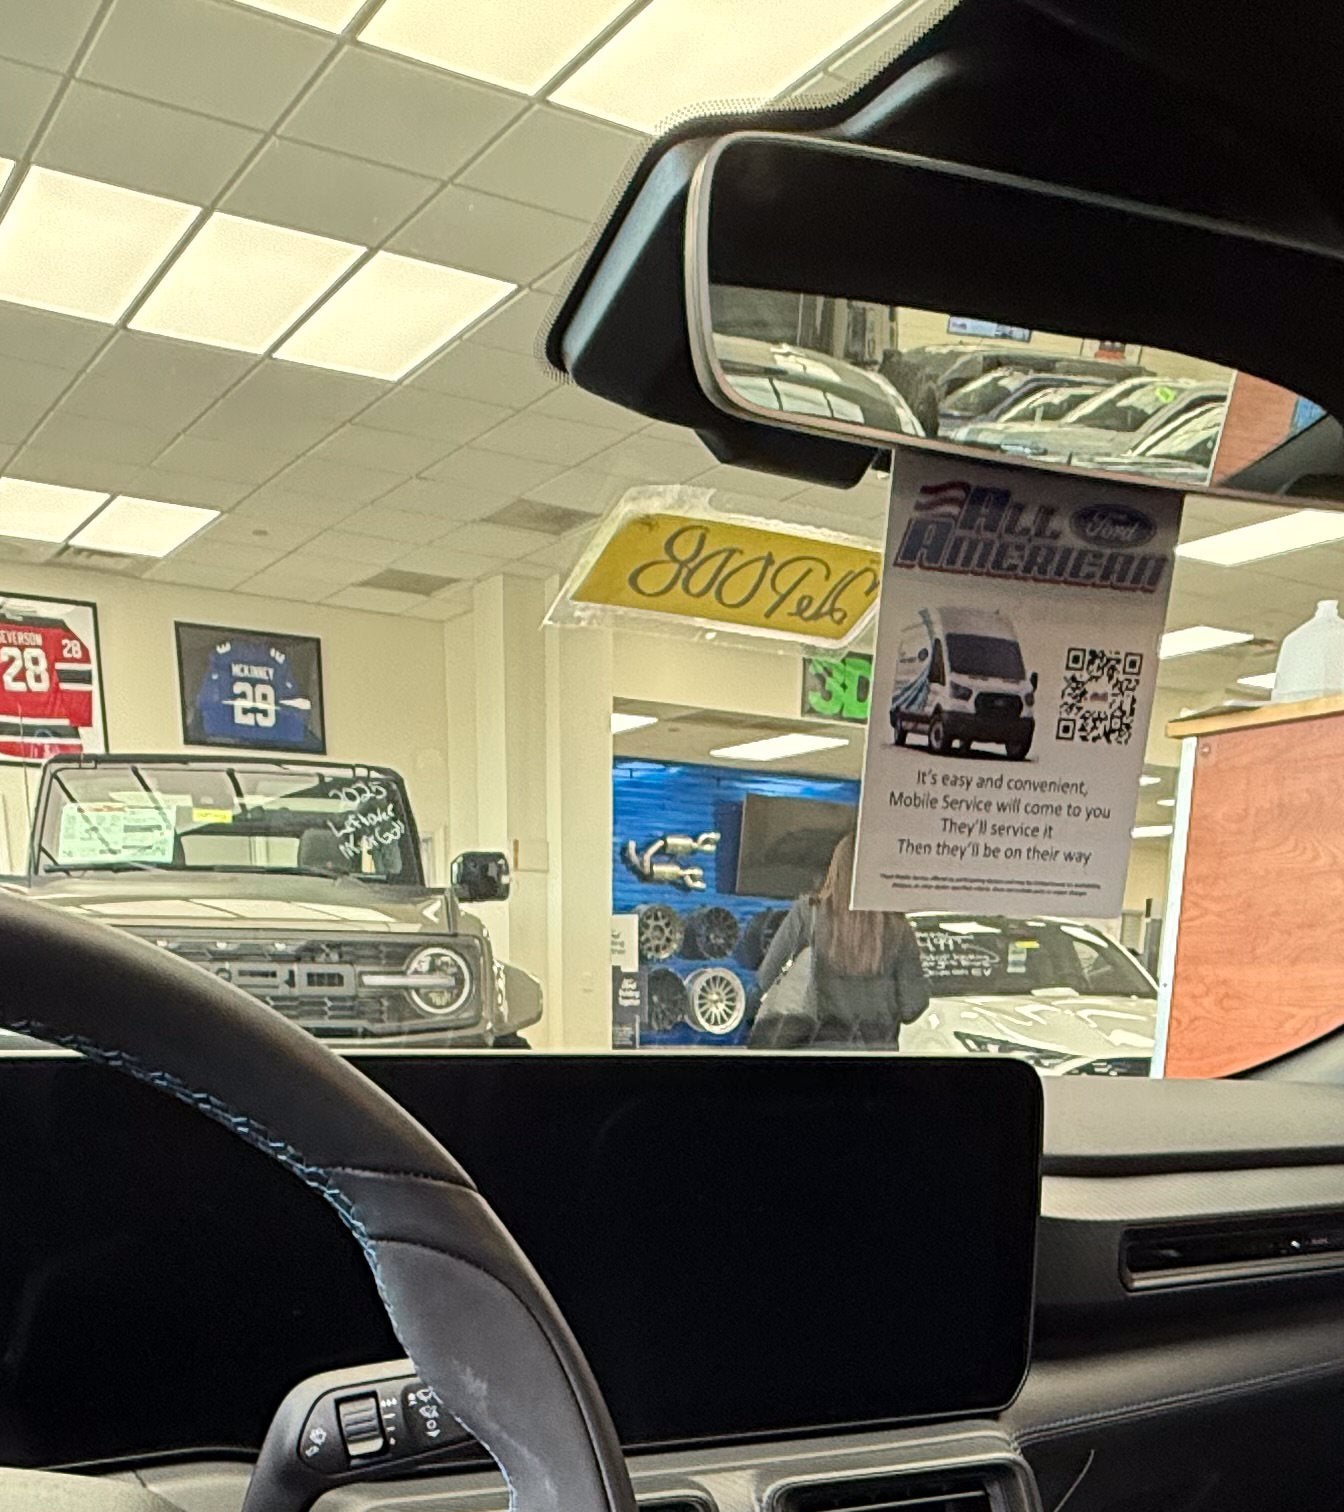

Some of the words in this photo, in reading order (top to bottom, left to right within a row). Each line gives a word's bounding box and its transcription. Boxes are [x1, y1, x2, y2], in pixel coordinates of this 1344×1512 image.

[956, 486, 1062, 541] ALL
[893, 519, 1169, 593] AMERICAN
[61, 638, 82, 659] 28
[0, 646, 50, 692] 28
[233, 681, 276, 727] 29
[916, 769, 937, 786] It's
[941, 774, 973, 791] easy
[976, 774, 1003, 789] and
[1006, 777, 1088, 797] convenient,
[889, 791, 938, 809] Mobile
[941, 795, 992, 812] Service
[996, 799, 1021, 814] will
[1024, 803, 1062, 816] come
[1066, 803, 1080, 817] to
[1086, 807, 1111, 822] you
[941, 817, 988, 836] They'll
[990, 821, 1038, 838] service
[1043, 825, 1053, 838] it
[897, 838, 932, 855] Then
[936, 841, 979, 860] they'll
[982, 842, 1001, 858] be
[1004, 846, 1022, 860] on
[1026, 846, 1059, 862] their
[1063, 850, 1092, 865] way
